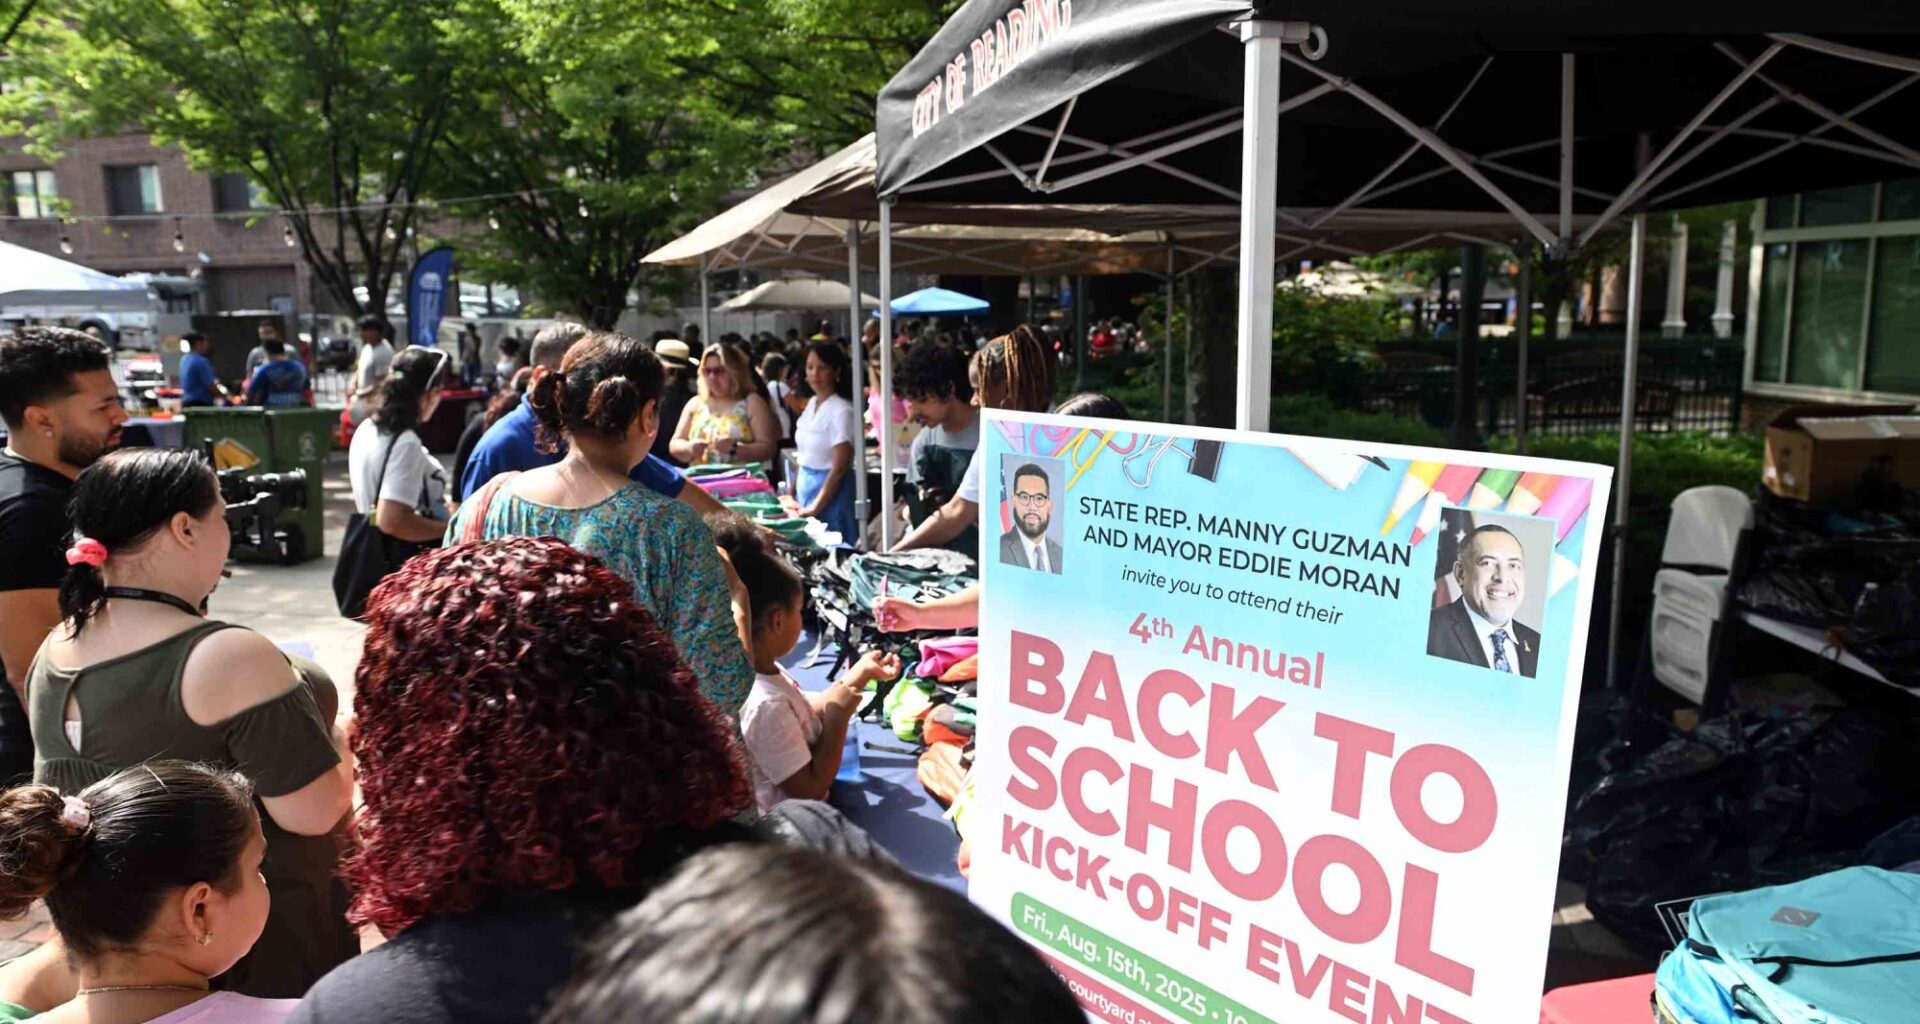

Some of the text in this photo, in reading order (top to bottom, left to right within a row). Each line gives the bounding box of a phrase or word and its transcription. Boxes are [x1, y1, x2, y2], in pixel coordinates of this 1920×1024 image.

[912, 75, 942, 139] CITY
[945, 53, 967, 114] OF
[1080, 496, 1412, 567] STATE REP. MANNY GUZMAN
[1083, 525, 1401, 600] AND MAYOR EDDIE MORAN
[1121, 564, 1344, 625] invite you to attend their
[1128, 612, 1325, 689] 4th Annual
[1008, 629, 1498, 854] BACK TO
[1006, 725, 1476, 997] SCHOOL
[1001, 814, 1473, 1024] KICK-OFF EVEN
[1058, 925, 1101, 963] Aug.
[1105, 946, 1152, 992] 15th,
[1155, 973, 1207, 1017] 2025
[1068, 979, 1136, 1024] courtyard
